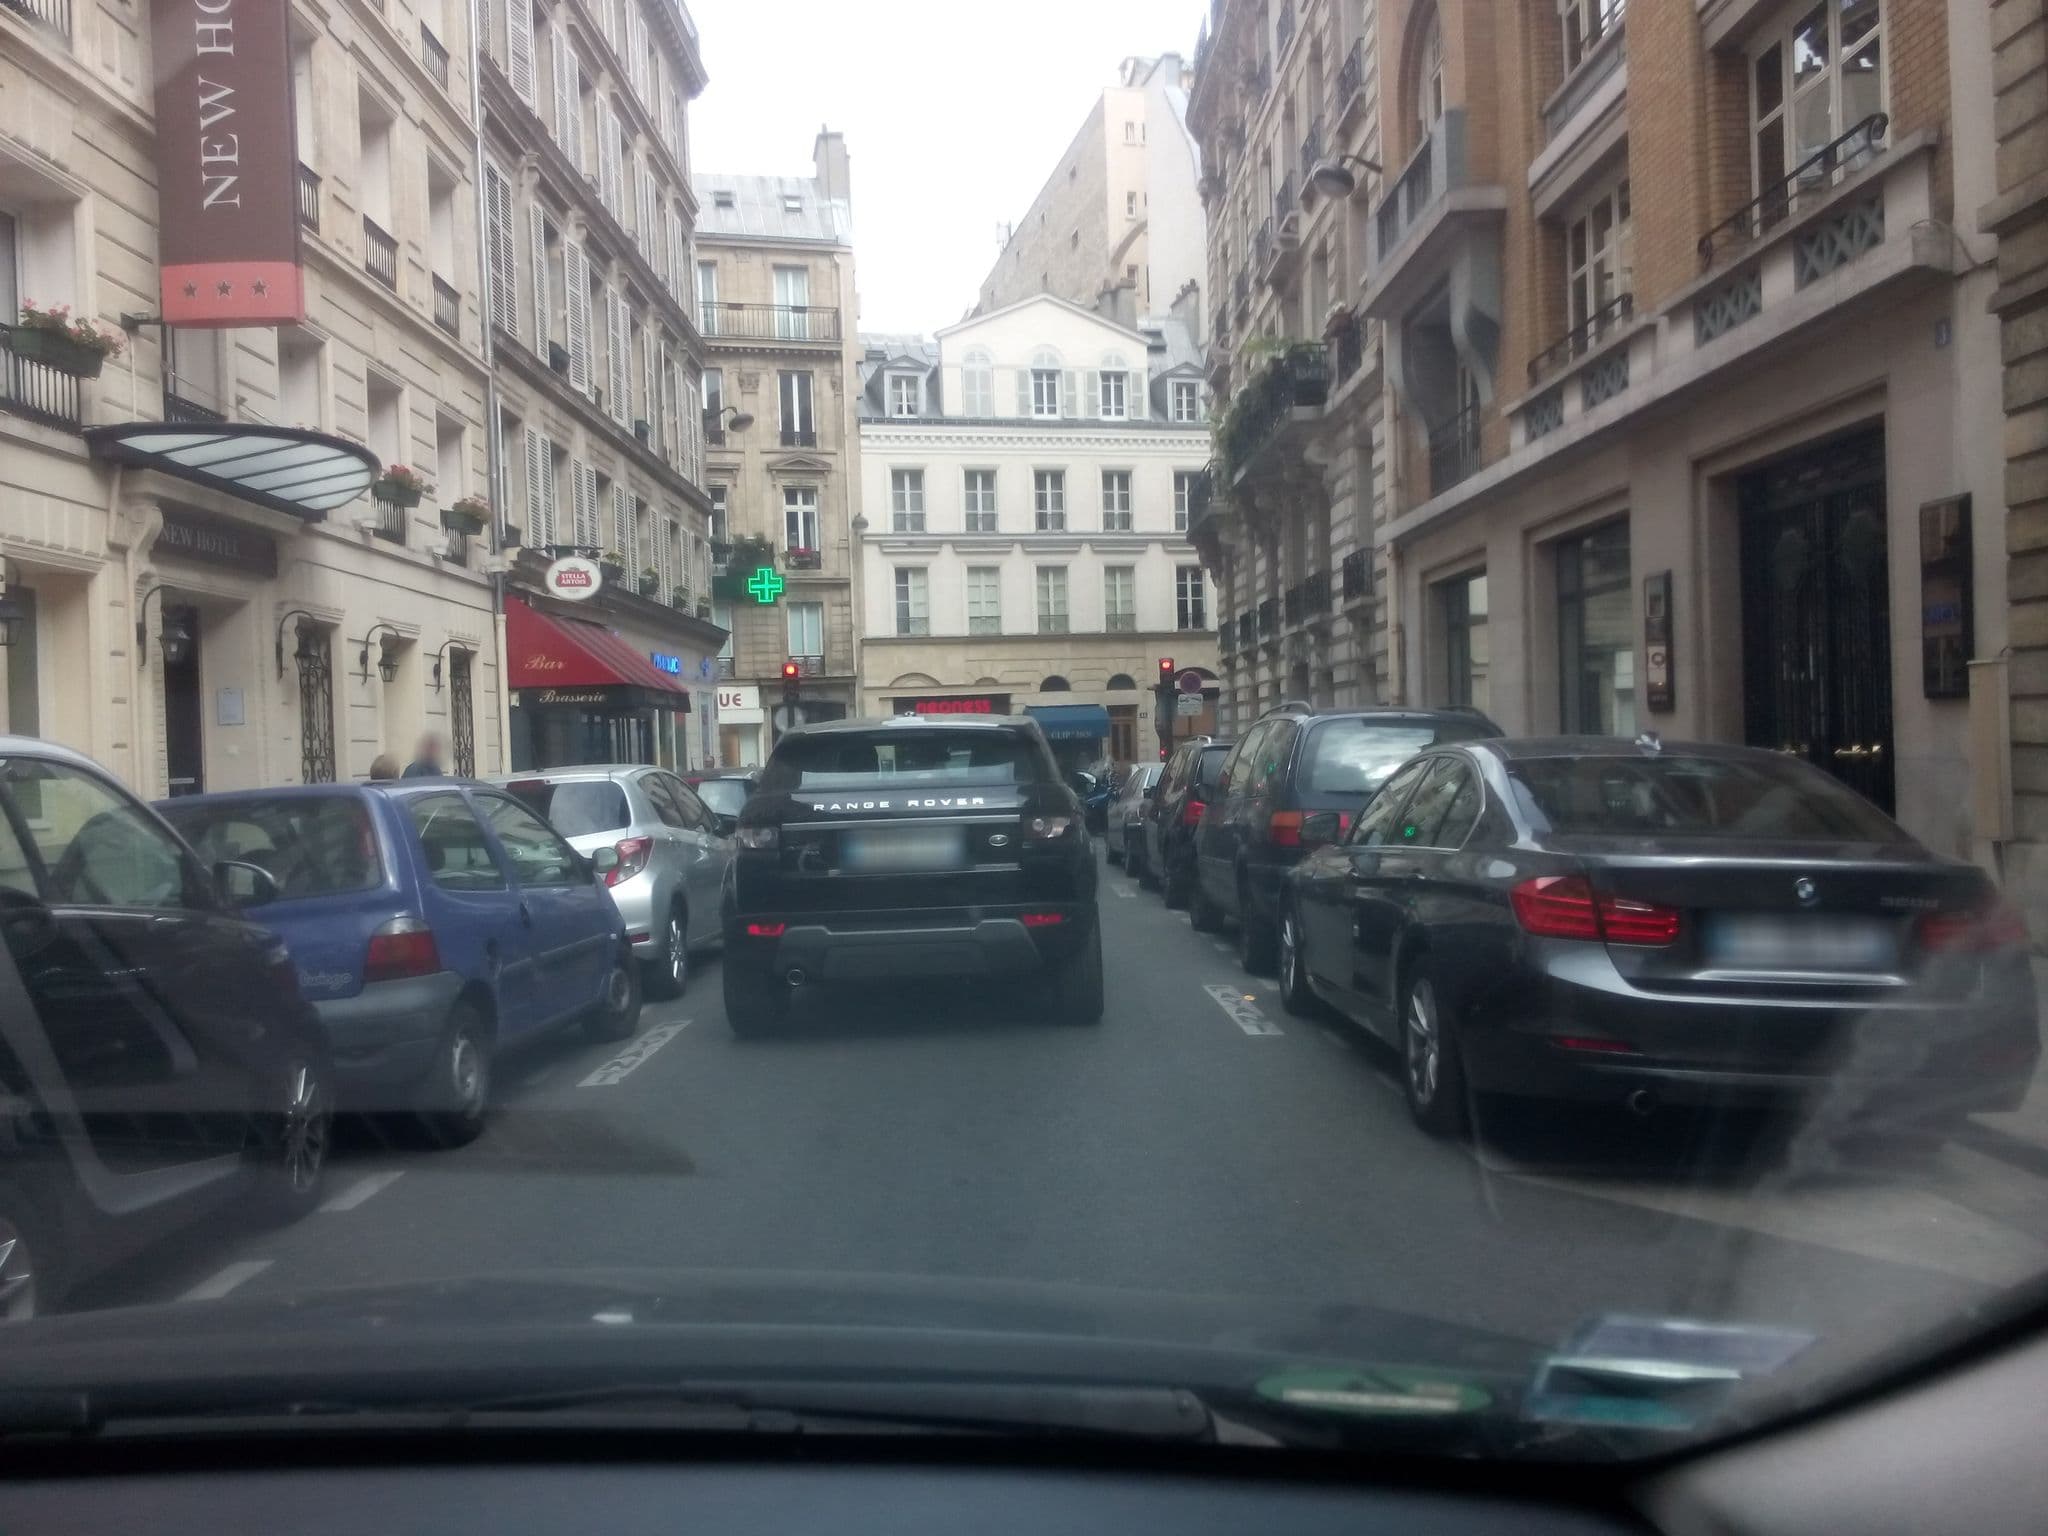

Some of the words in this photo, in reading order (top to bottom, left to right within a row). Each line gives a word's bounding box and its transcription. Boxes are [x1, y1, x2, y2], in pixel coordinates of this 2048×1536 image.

[198, 75, 240, 210] NEW
[524, 655, 564, 669] Bar
[539, 690, 605, 703] Brasserie
[813, 801, 890, 811] RANGE
[907, 797, 985, 807] ROVER
